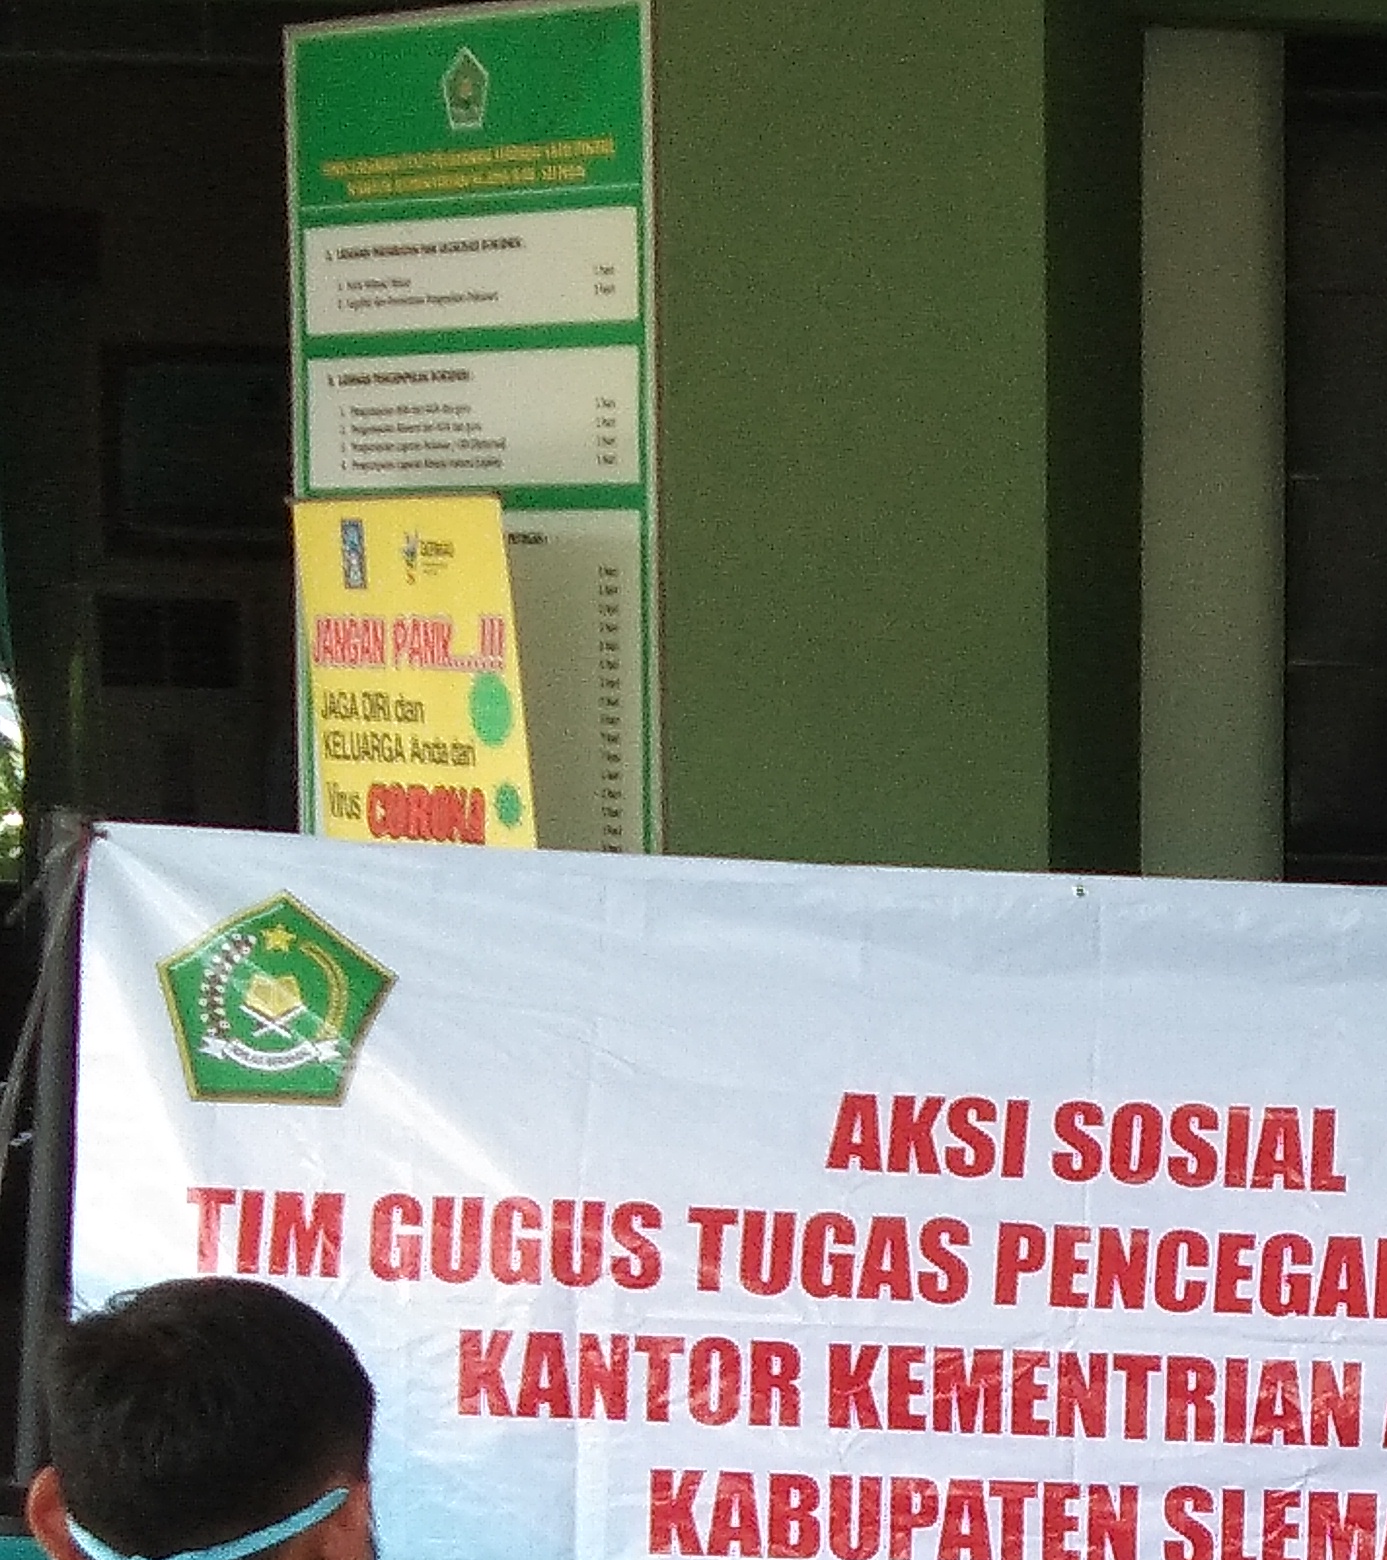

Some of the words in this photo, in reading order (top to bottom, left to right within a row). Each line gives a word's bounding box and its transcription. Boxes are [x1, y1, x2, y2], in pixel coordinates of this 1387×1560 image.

[314, 616, 385, 667] JANGAN
[321, 691, 359, 721] JAGA
[362, 691, 391, 722] DIRI
[395, 693, 424, 724] dan
[323, 731, 407, 764] KELUARGA
[326, 781, 361, 821] Virus
[367, 783, 486, 846] CORONA
[827, 1093, 1028, 1178] AKSI
[1052, 1101, 1346, 1191] SOSIAL
[187, 1188, 345, 1277] TIM
[371, 1195, 662, 1290] GUGUS
[689, 1208, 969, 1304] TUGAS
[458, 1331, 801, 1427] KANTOR
[828, 1344, 1361, 1448] KEMENTRIAN
